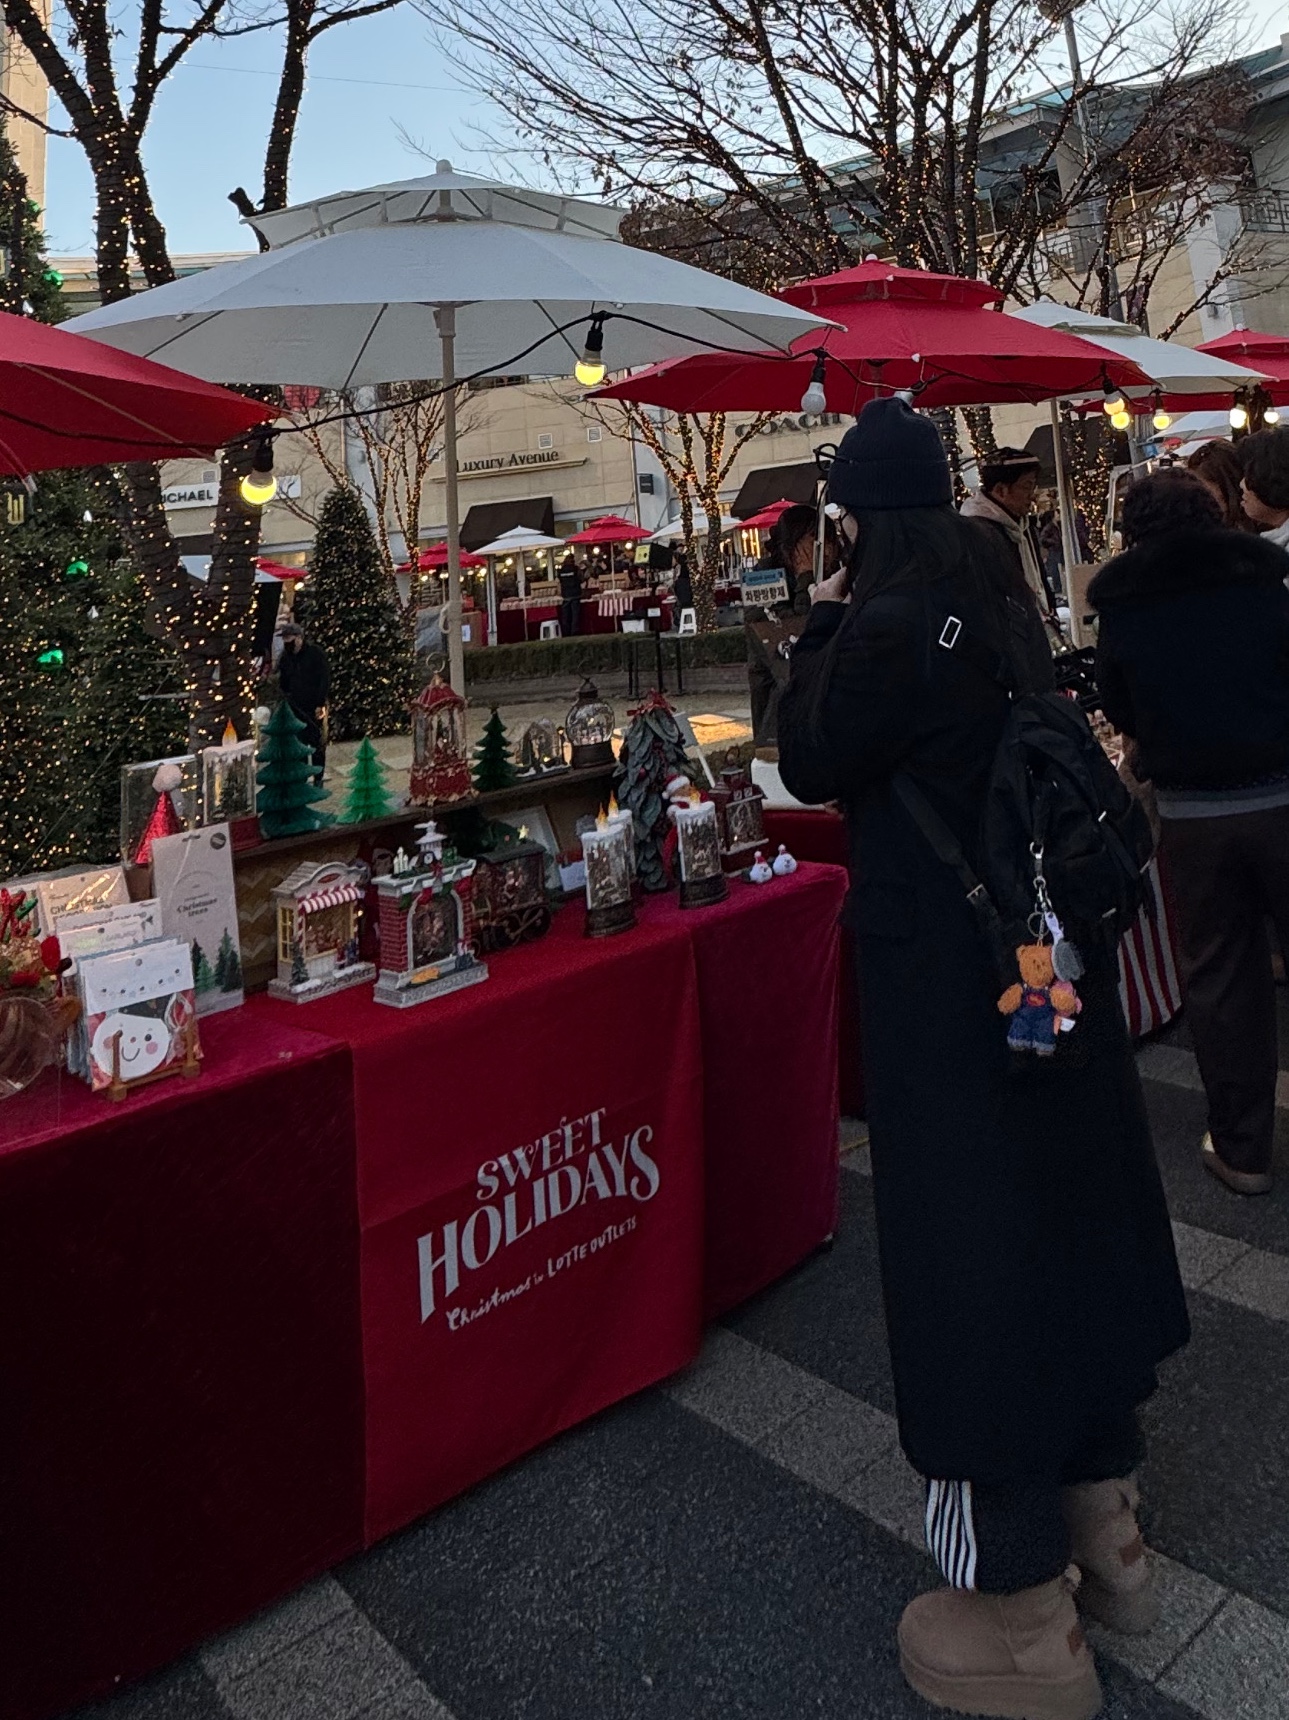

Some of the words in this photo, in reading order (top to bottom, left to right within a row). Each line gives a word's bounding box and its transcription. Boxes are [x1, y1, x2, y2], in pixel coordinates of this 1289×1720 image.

[161, 489, 214, 504] ICHAEL
[456, 457, 504, 473] Luxury
[509, 450, 560, 467] Avenue
[476, 1107, 607, 1200] SWEET
[417, 1125, 660, 1325] HOLIDAYS
[446, 1274, 532, 1331] Christmas
[547, 1245, 588, 1278] LOTTE
[590, 1215, 638, 1254] OUTLETS
